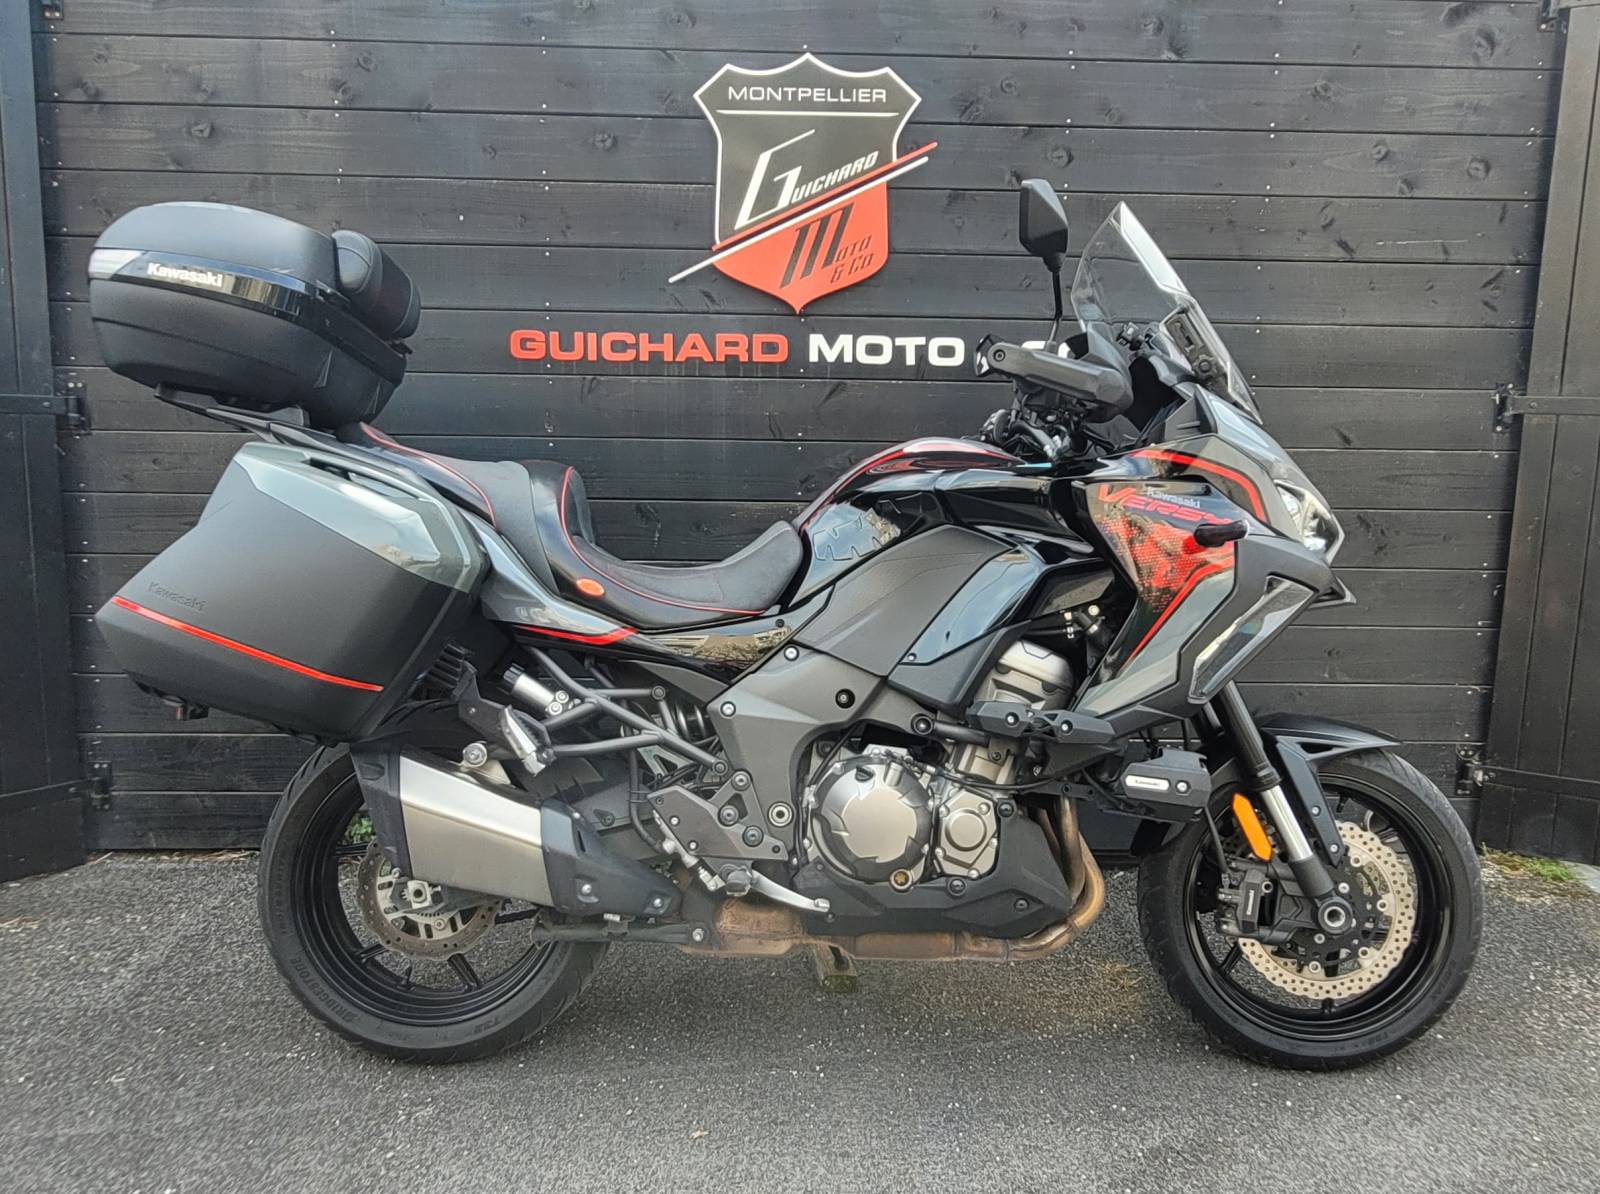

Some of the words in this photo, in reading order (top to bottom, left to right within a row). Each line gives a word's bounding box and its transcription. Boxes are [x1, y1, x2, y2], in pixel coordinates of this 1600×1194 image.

[728, 86, 887, 103] MONTPELLIER
[779, 202, 872, 289] MOTO
[147, 262, 222, 287] Kawasaki
[509, 329, 789, 364] GUICHARD
[807, 333, 966, 367] MOTO
[1145, 486, 1201, 509] Kawasaki
[147, 581, 207, 611] Kawasaki
